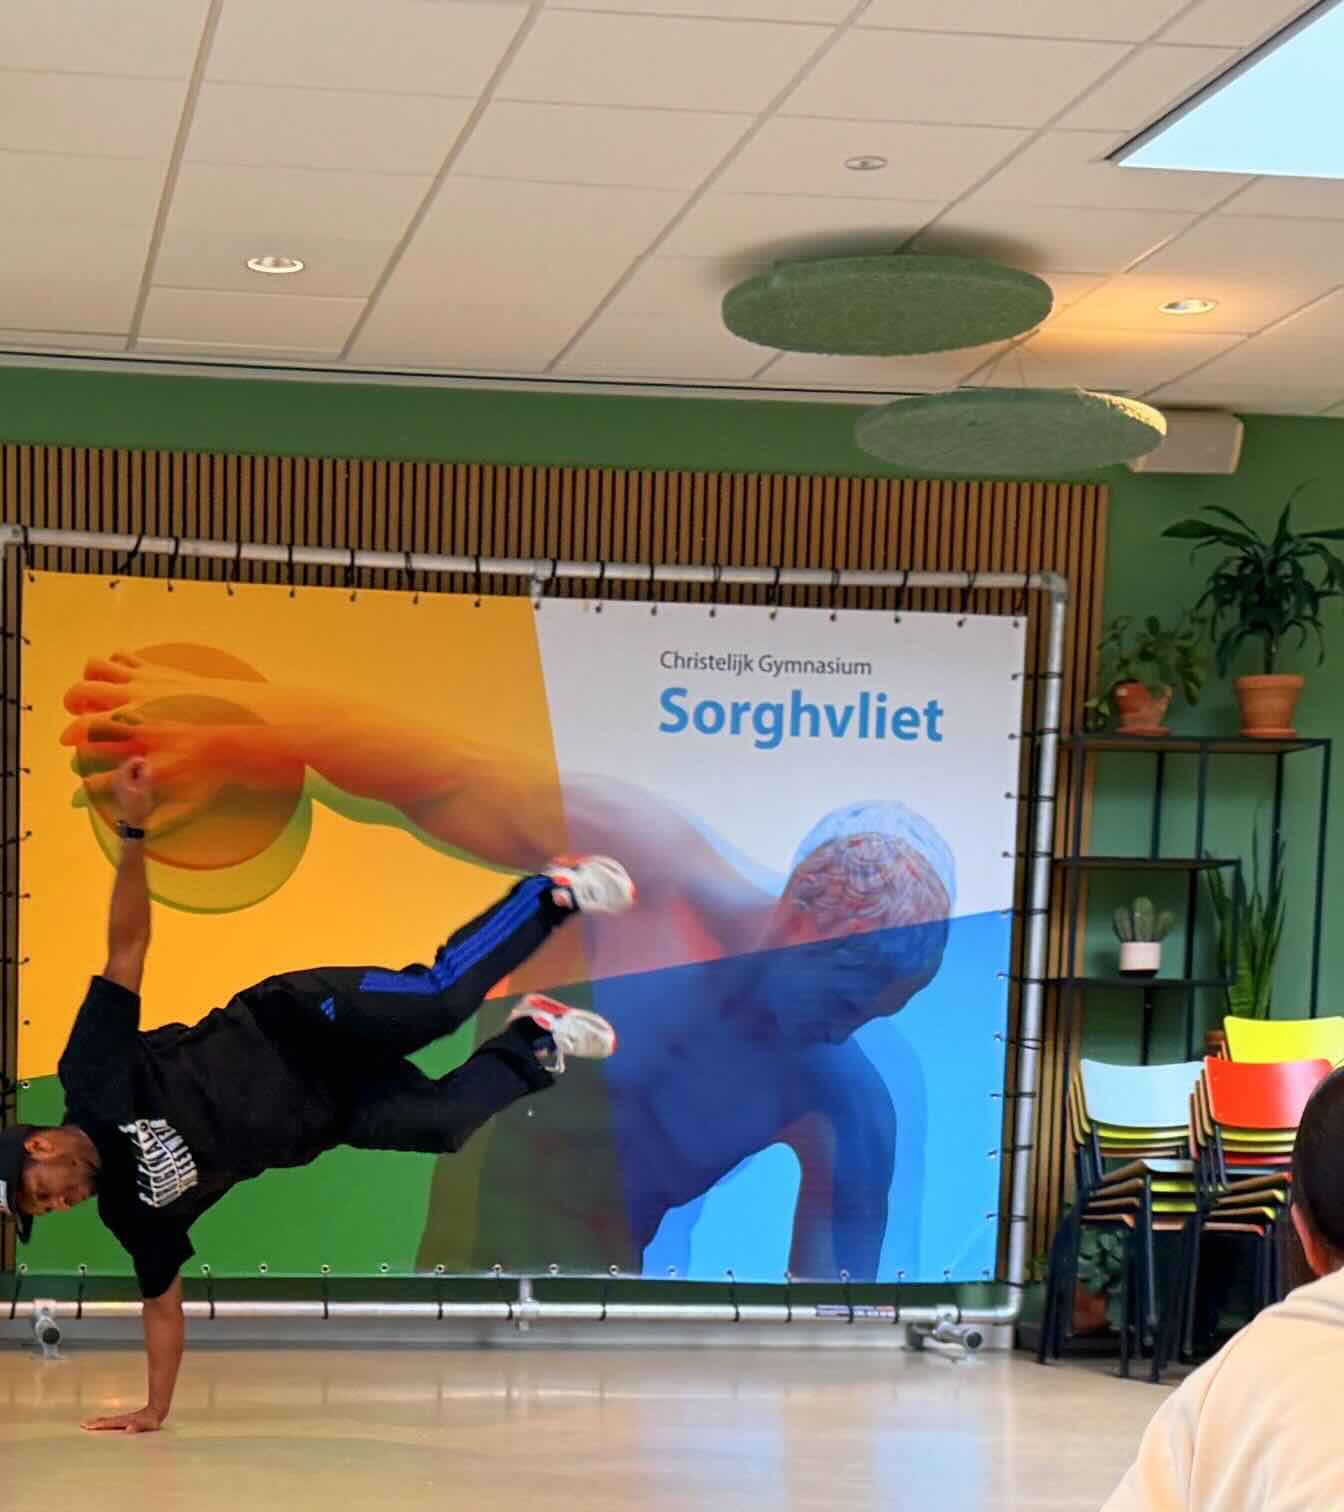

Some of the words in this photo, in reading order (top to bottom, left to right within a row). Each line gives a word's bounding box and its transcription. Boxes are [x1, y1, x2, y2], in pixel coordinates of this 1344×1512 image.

[659, 650, 754, 677] Christelijk
[758, 653, 873, 678] Gymnasium
[658, 686, 945, 750] Sorghvliet
